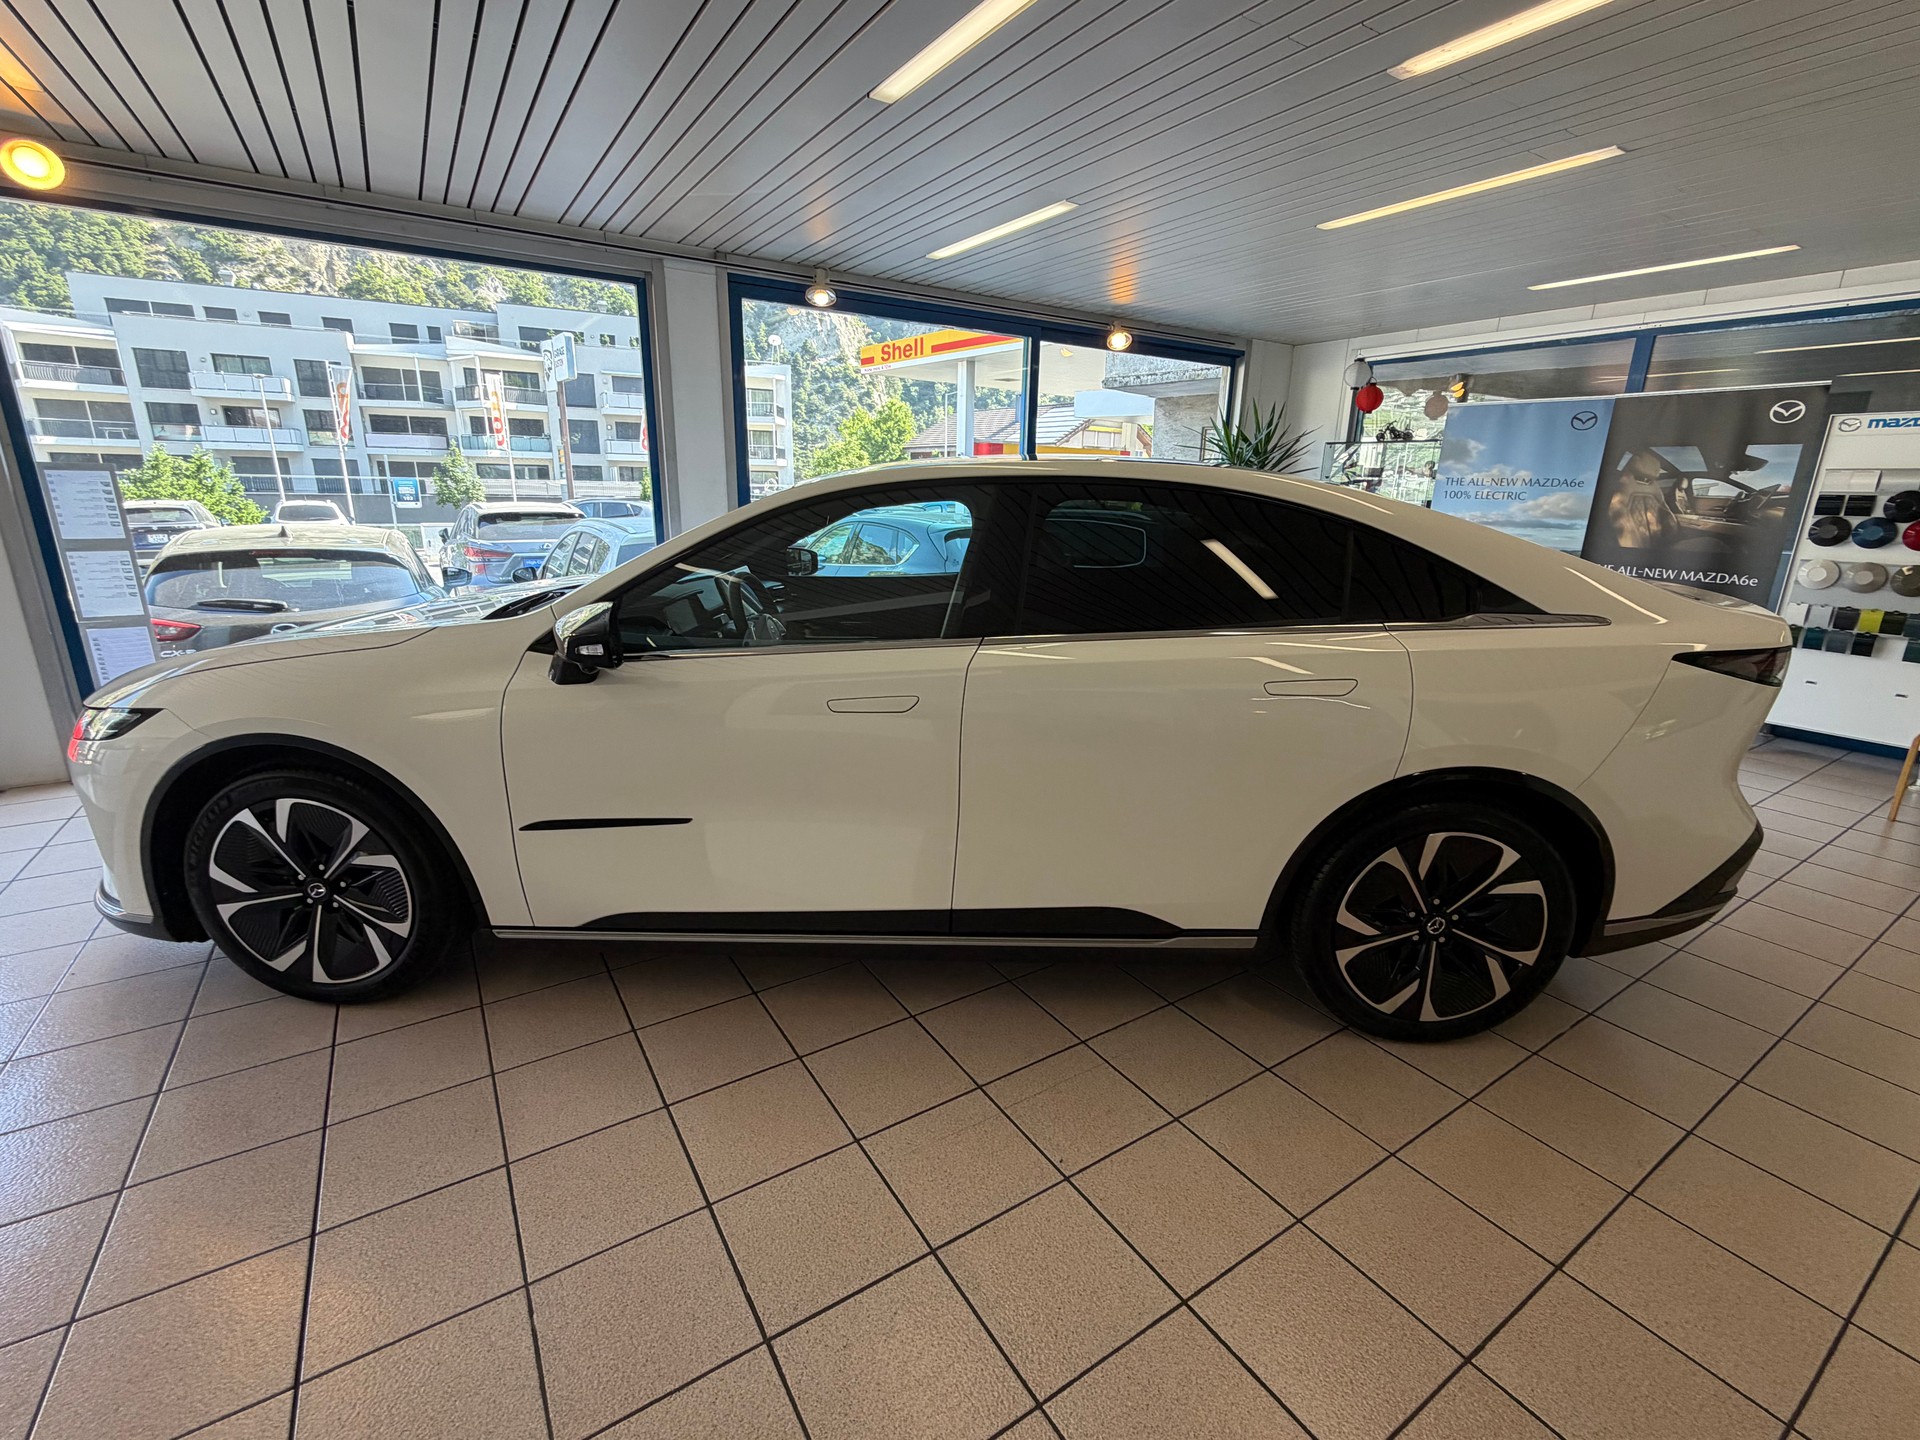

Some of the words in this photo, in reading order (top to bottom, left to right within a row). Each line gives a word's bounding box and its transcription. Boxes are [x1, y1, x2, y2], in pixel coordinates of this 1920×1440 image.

[880, 337, 924, 362] Shell
[1445, 477, 1465, 487] THE
[1467, 477, 1519, 487] ALL-NEW
[1520, 478, 1585, 488] MAZDA6e
[1444, 490, 1471, 499] 100%
[1474, 491, 1527, 500] ELECTRIC
[1617, 565, 1678, 580] ALL-NEW
[1679, 570, 1759, 587] MAZDA6e
